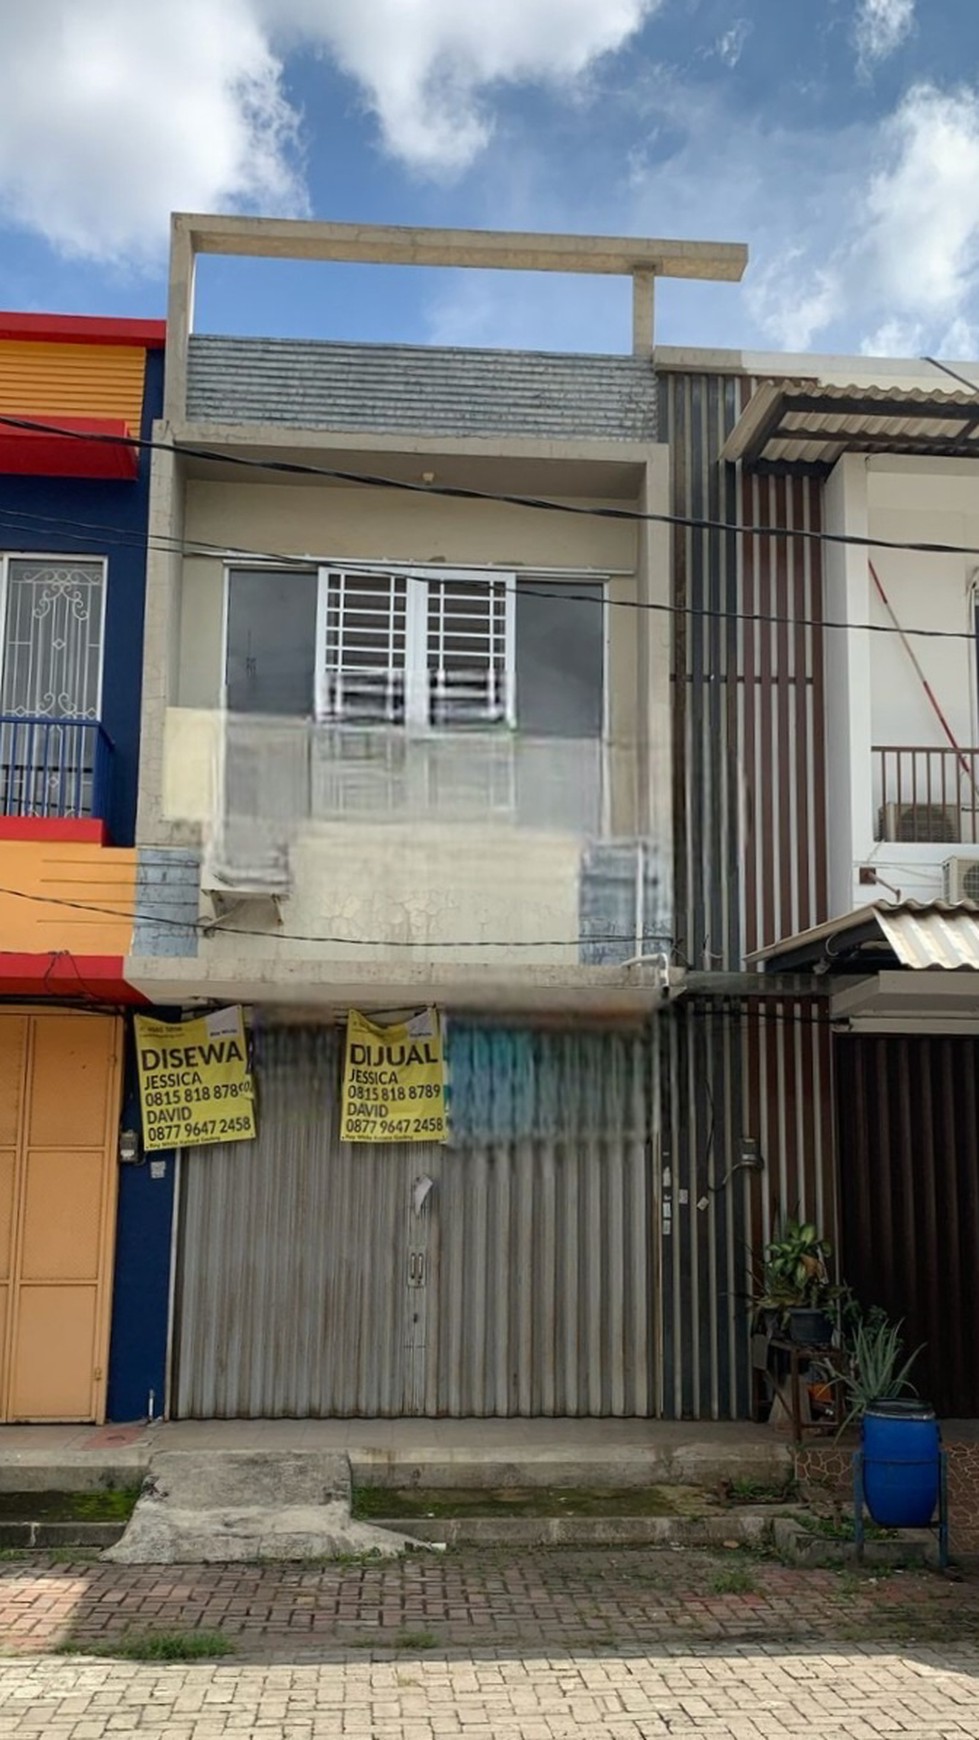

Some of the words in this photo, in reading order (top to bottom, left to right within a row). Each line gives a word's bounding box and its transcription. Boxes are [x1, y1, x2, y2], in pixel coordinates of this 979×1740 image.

[141, 1041, 244, 1071] DISEWA
[349, 1043, 438, 1067] DIJUAL
[144, 1071, 202, 1090] JESSICA
[348, 1069, 398, 1085] JESSICA
[145, 1089, 180, 1107] 0815
[184, 1086, 210, 1103] 818
[347, 1085, 379, 1101] 0815
[381, 1086, 406, 1101] 818
[408, 1084, 441, 1099] 8789
[146, 1106, 192, 1125] DAVID
[347, 1102, 389, 1118] DAVID
[148, 1124, 181, 1141] 0877
[184, 1120, 217, 1138] 9647
[219, 1116, 252, 1134] 2458
[346, 1118, 377, 1133] 0877
[379, 1119, 411, 1134] 9647
[413, 1117, 444, 1133] 2458
